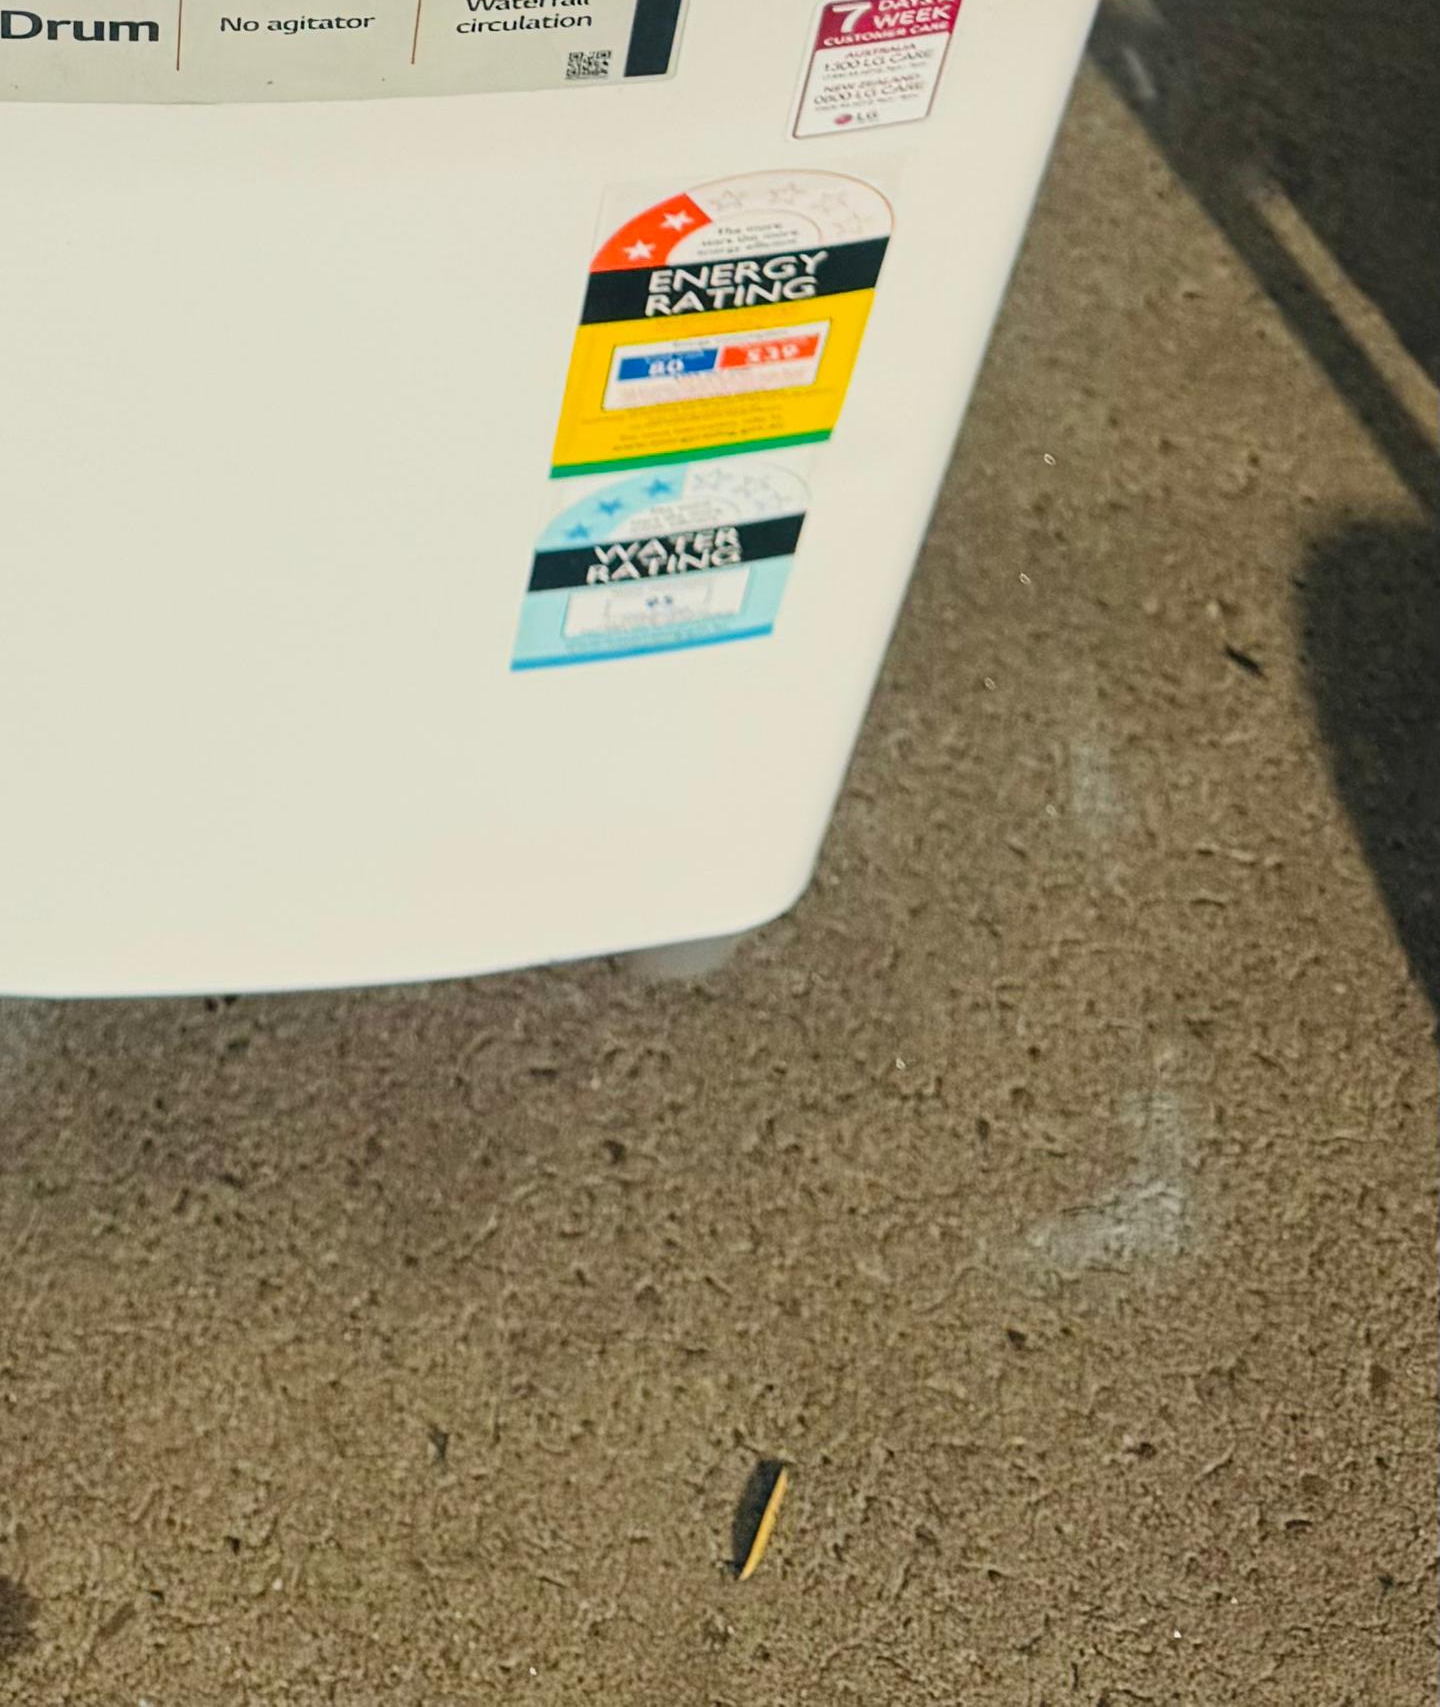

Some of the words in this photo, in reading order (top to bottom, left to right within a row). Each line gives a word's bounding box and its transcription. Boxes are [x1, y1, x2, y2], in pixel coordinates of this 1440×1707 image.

[220, 13, 260, 33] No
[267, 11, 376, 37] agitator
[456, 11, 593, 35] circulation
[831, 1, 872, 34] 7
[872, 4, 952, 30] WEEK
[823, 28, 906, 46] CUSTOMER
[648, 249, 829, 293] ENERGY
[645, 277, 819, 317] RATING
[592, 526, 743, 567] WATER
[585, 546, 743, 586] RATING
